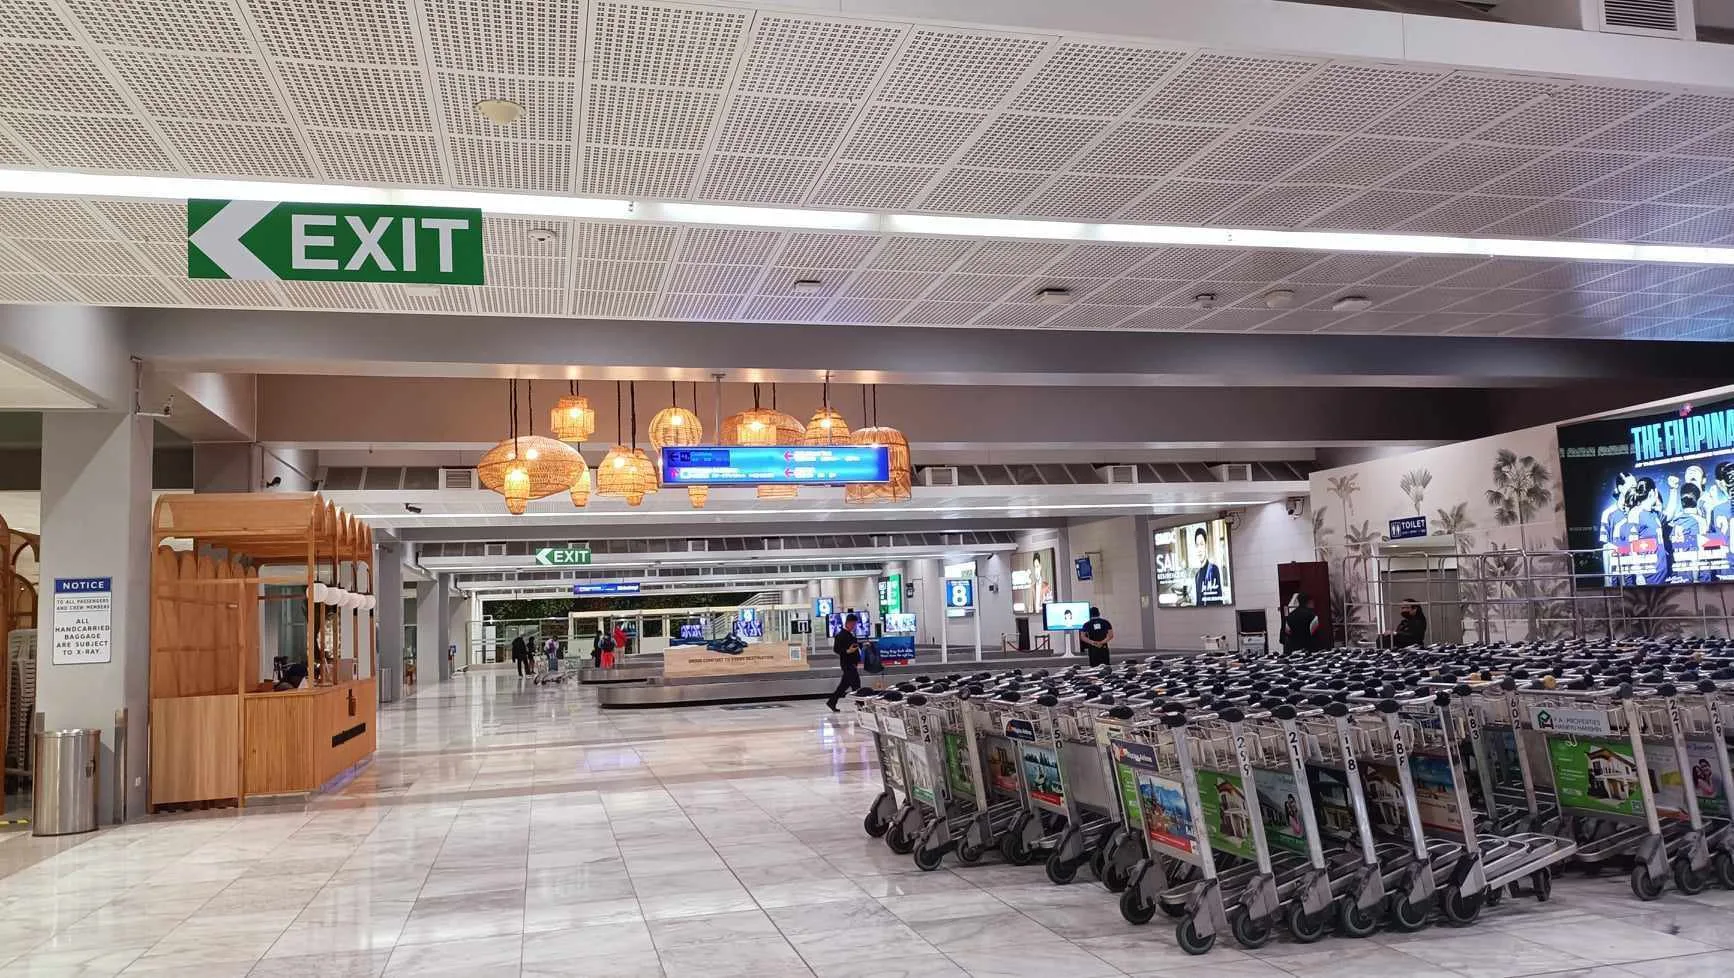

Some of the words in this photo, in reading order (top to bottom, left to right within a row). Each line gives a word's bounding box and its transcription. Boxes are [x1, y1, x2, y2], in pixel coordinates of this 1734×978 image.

[291, 214, 469, 273] EXIT
[1631, 419, 1663, 461] THE
[1401, 519, 1425, 529] TOILET
[553, 550, 588, 563] EXIT
[63, 581, 104, 590] NOTICE
[952, 585, 968, 607] 8
[55, 625, 110, 633] HANDCARRIED
[920, 715, 931, 743] 934
[1467, 708, 1480, 740] 483
[1510, 698, 1521, 729] 602
[1669, 699, 1681, 733] 221
[1710, 702, 1722, 737] 429
[1288, 731, 1302, 769] 211
